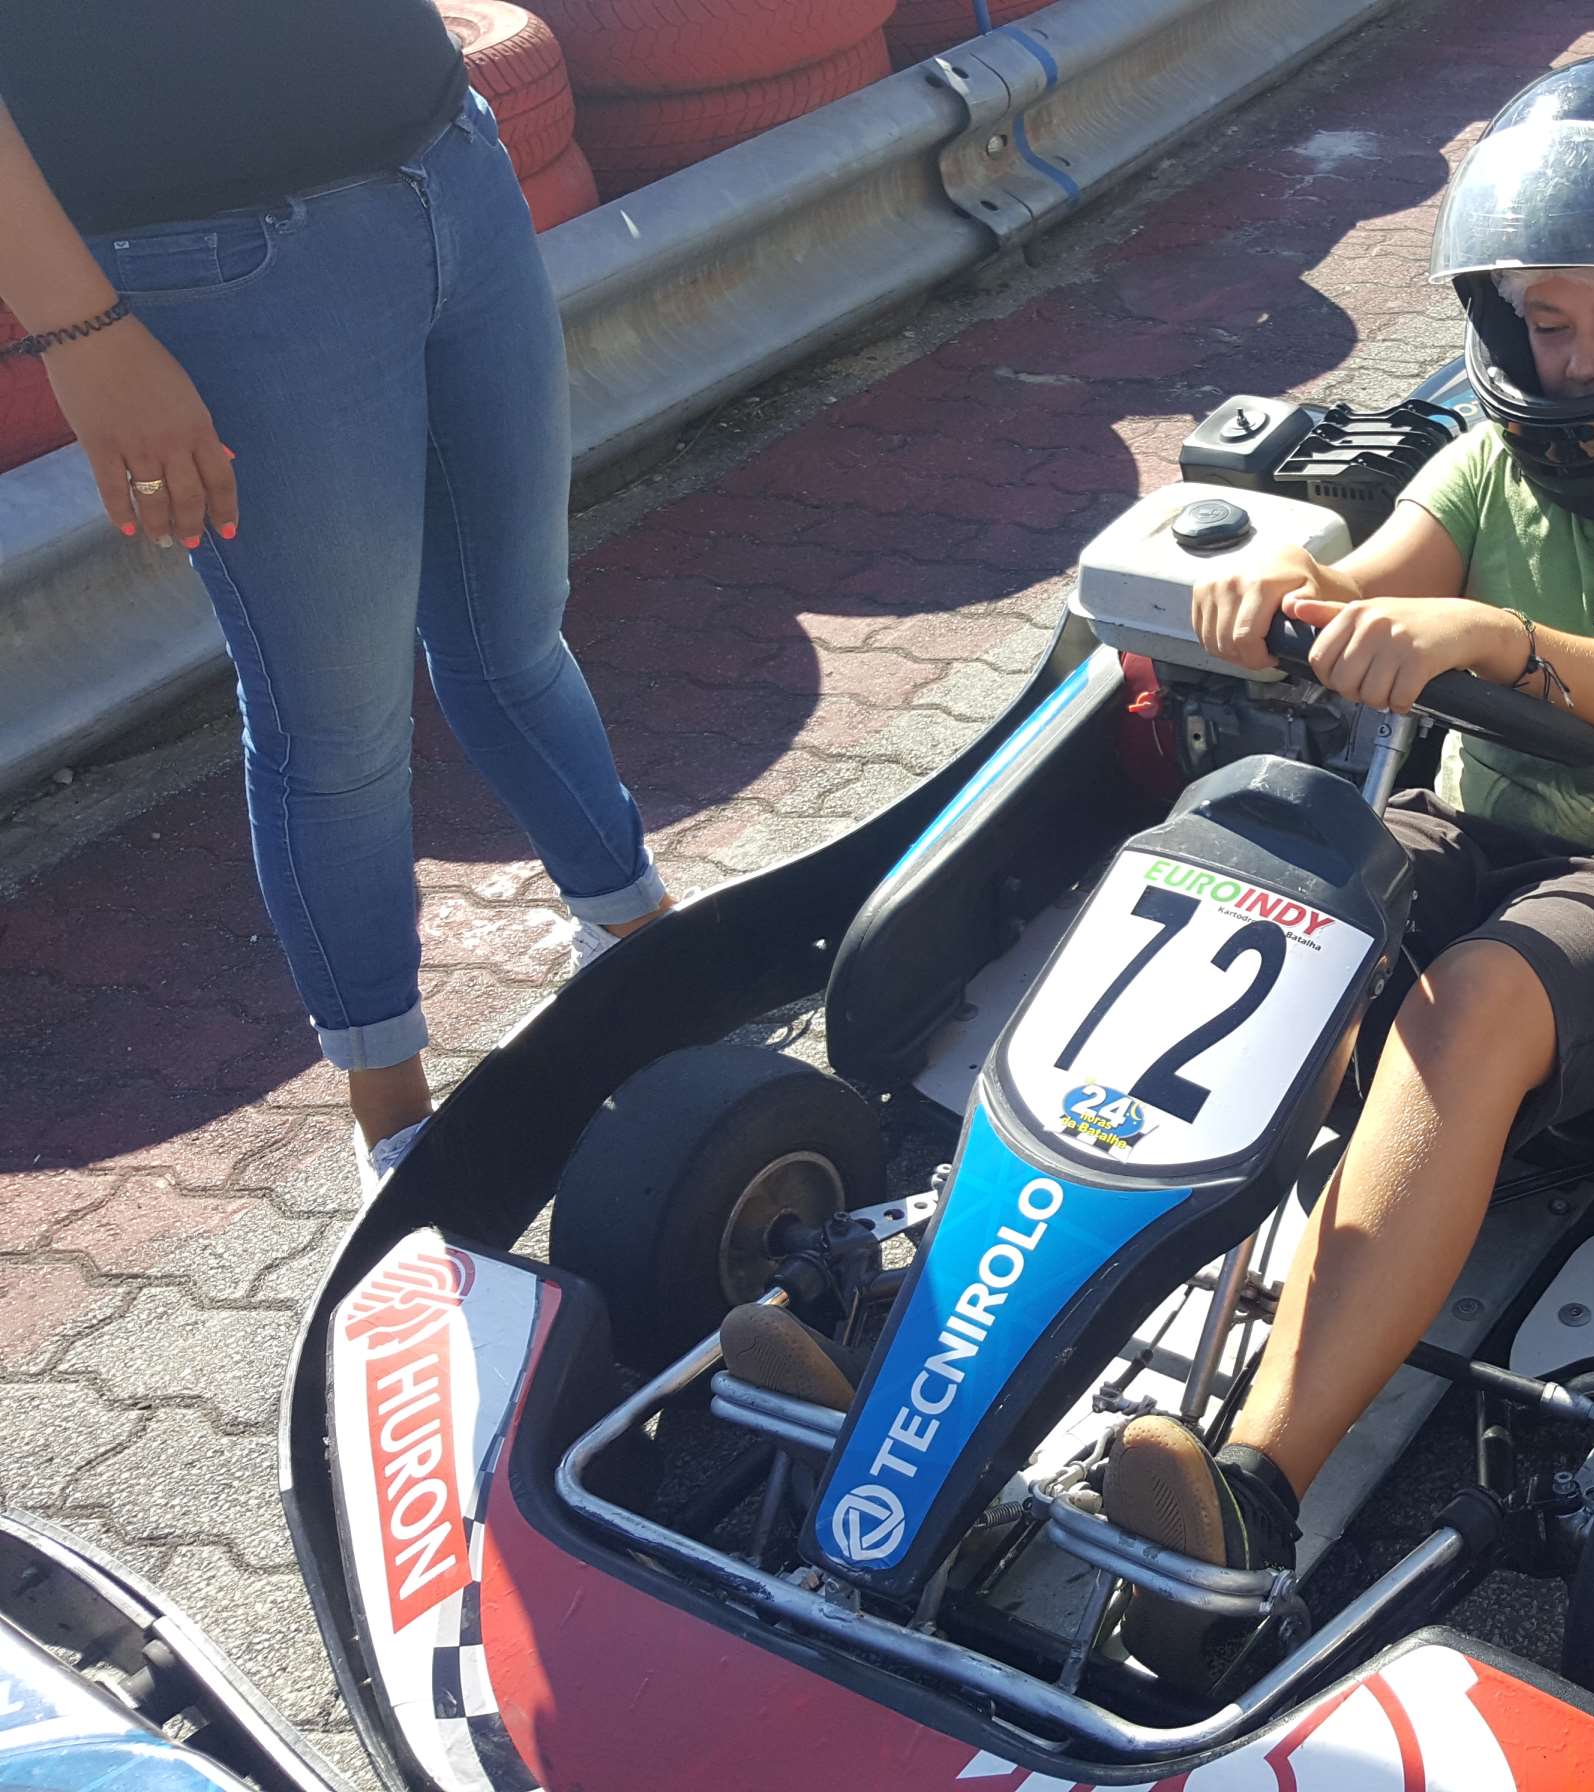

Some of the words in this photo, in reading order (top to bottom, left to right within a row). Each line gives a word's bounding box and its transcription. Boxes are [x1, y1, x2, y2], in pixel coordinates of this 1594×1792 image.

[1144, 859, 1335, 937] EUROINDY
[1285, 930, 1322, 951] Batalha
[1053, 885, 1287, 1124] 72
[1071, 1085, 1131, 1128] 24
[870, 1177, 1064, 1478] TECNIROLO
[375, 1353, 456, 1602] HURON
